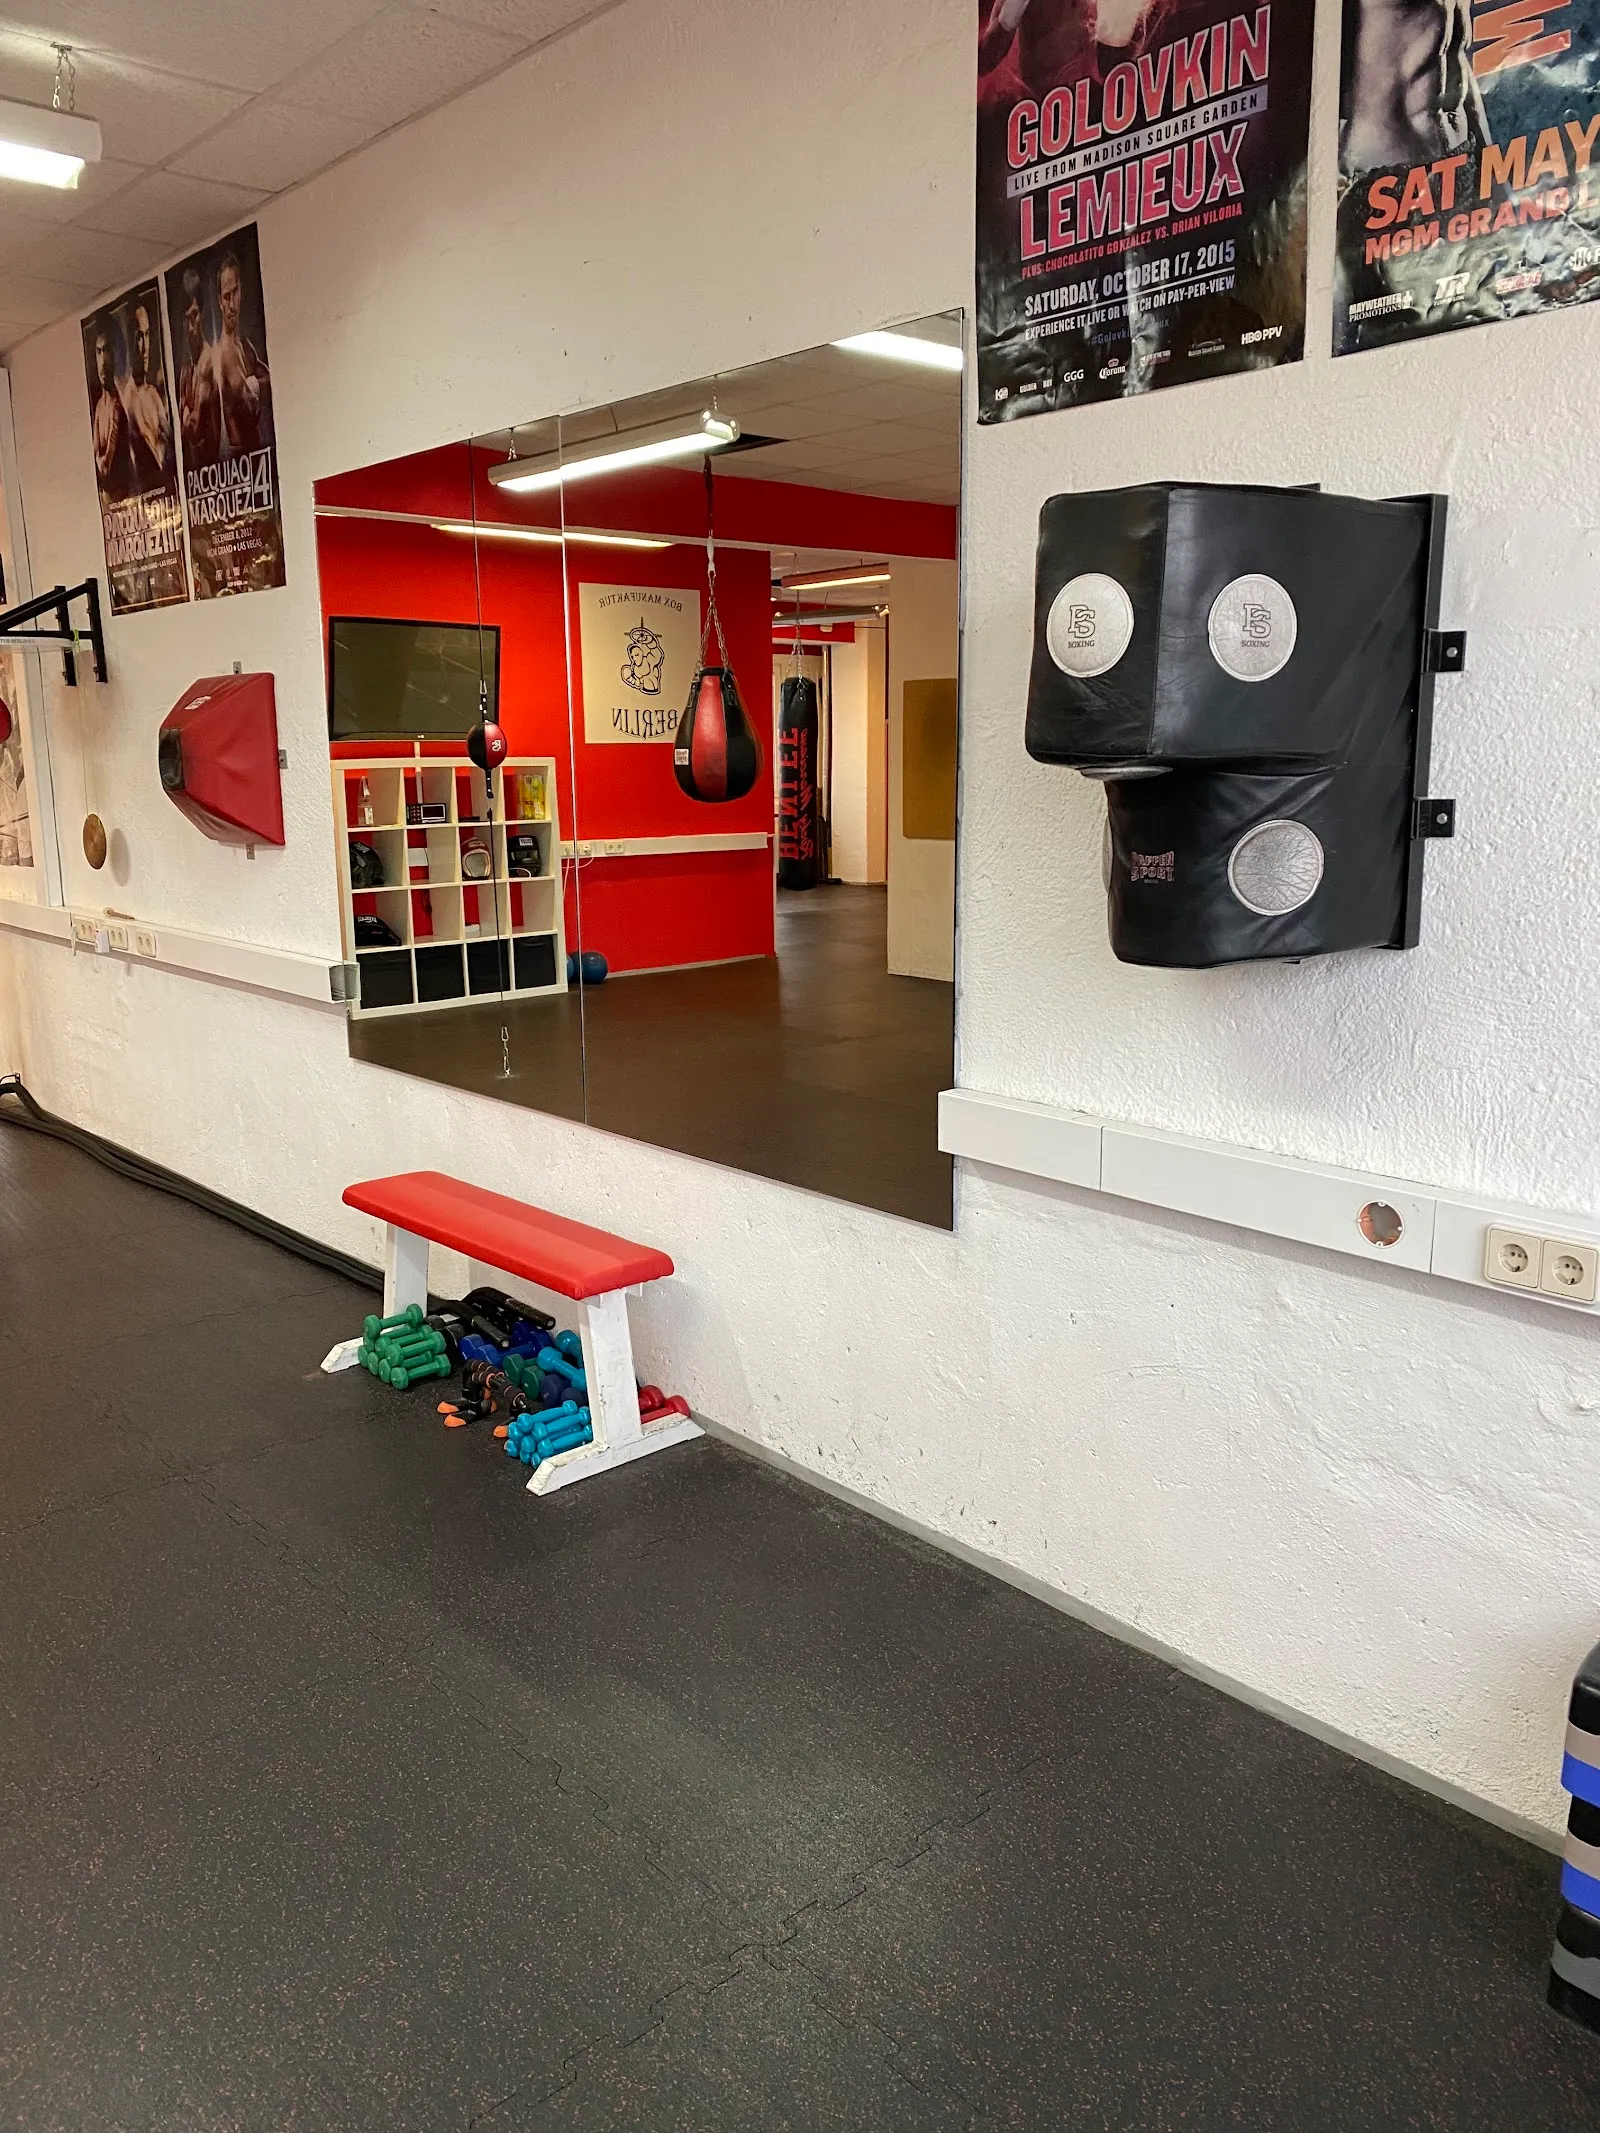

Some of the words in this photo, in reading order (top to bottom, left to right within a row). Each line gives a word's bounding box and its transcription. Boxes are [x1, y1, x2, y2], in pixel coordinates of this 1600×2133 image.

[1007, 4, 1271, 169] GOLOVKIN
[1014, 170, 1039, 191] LIVE
[1045, 157, 1076, 178] FROM
[1083, 135, 1140, 167] MADISON
[1147, 116, 1196, 146] SQUARE
[1203, 93, 1258, 124] GARDEN
[1366, 154, 1468, 229] SAT
[1480, 114, 1600, 200] MAY
[1020, 121, 1248, 261] LEMIEUX
[1045, 245, 1104, 272] CHOCOLATITO
[1107, 230, 1152, 255] GONZALEZ
[1172, 215, 1200, 235] BRIAN
[1203, 202, 1243, 225] VILORIA
[1365, 221, 1439, 265] MGM
[1447, 187, 1569, 243] GRAND
[1025, 278, 1099, 317] SATURDAY,
[1174, 251, 1193, 277] 17,
[1196, 239, 1236, 271] 2015
[1025, 316, 1075, 340] EXPERIENCE
[1077, 314, 1086, 328] IT
[1087, 309, 1106, 326] LIVE
[1108, 306, 1120, 320] OR
[1122, 295, 1152, 317] WTCH
[1153, 291, 1167, 308] ON
[1167, 275, 1236, 306] PAY-PER-VIEW
[1349, 293, 1402, 315] MAYWEATHER
[1349, 303, 1402, 322] PROMOTIONS
[1241, 331, 1262, 345] HBO
[1262, 325, 1283, 341] PPV
[1063, 369, 1084, 383] GGG
[1099, 365, 1126, 380] Corona
[187, 454, 251, 497] PACQUIAO
[254, 454, 270, 506] 4
[189, 486, 253, 528] MARQUEZ
[237, 541, 246, 551] LAS
[246, 538, 263, 549] VEGAS
[1068, 639, 1095, 649] BOXING
[1240, 640, 1270, 648] BOXING
[1130, 866, 1175, 882] SPORT
[1131, 850, 1175, 866] PAFFEN
